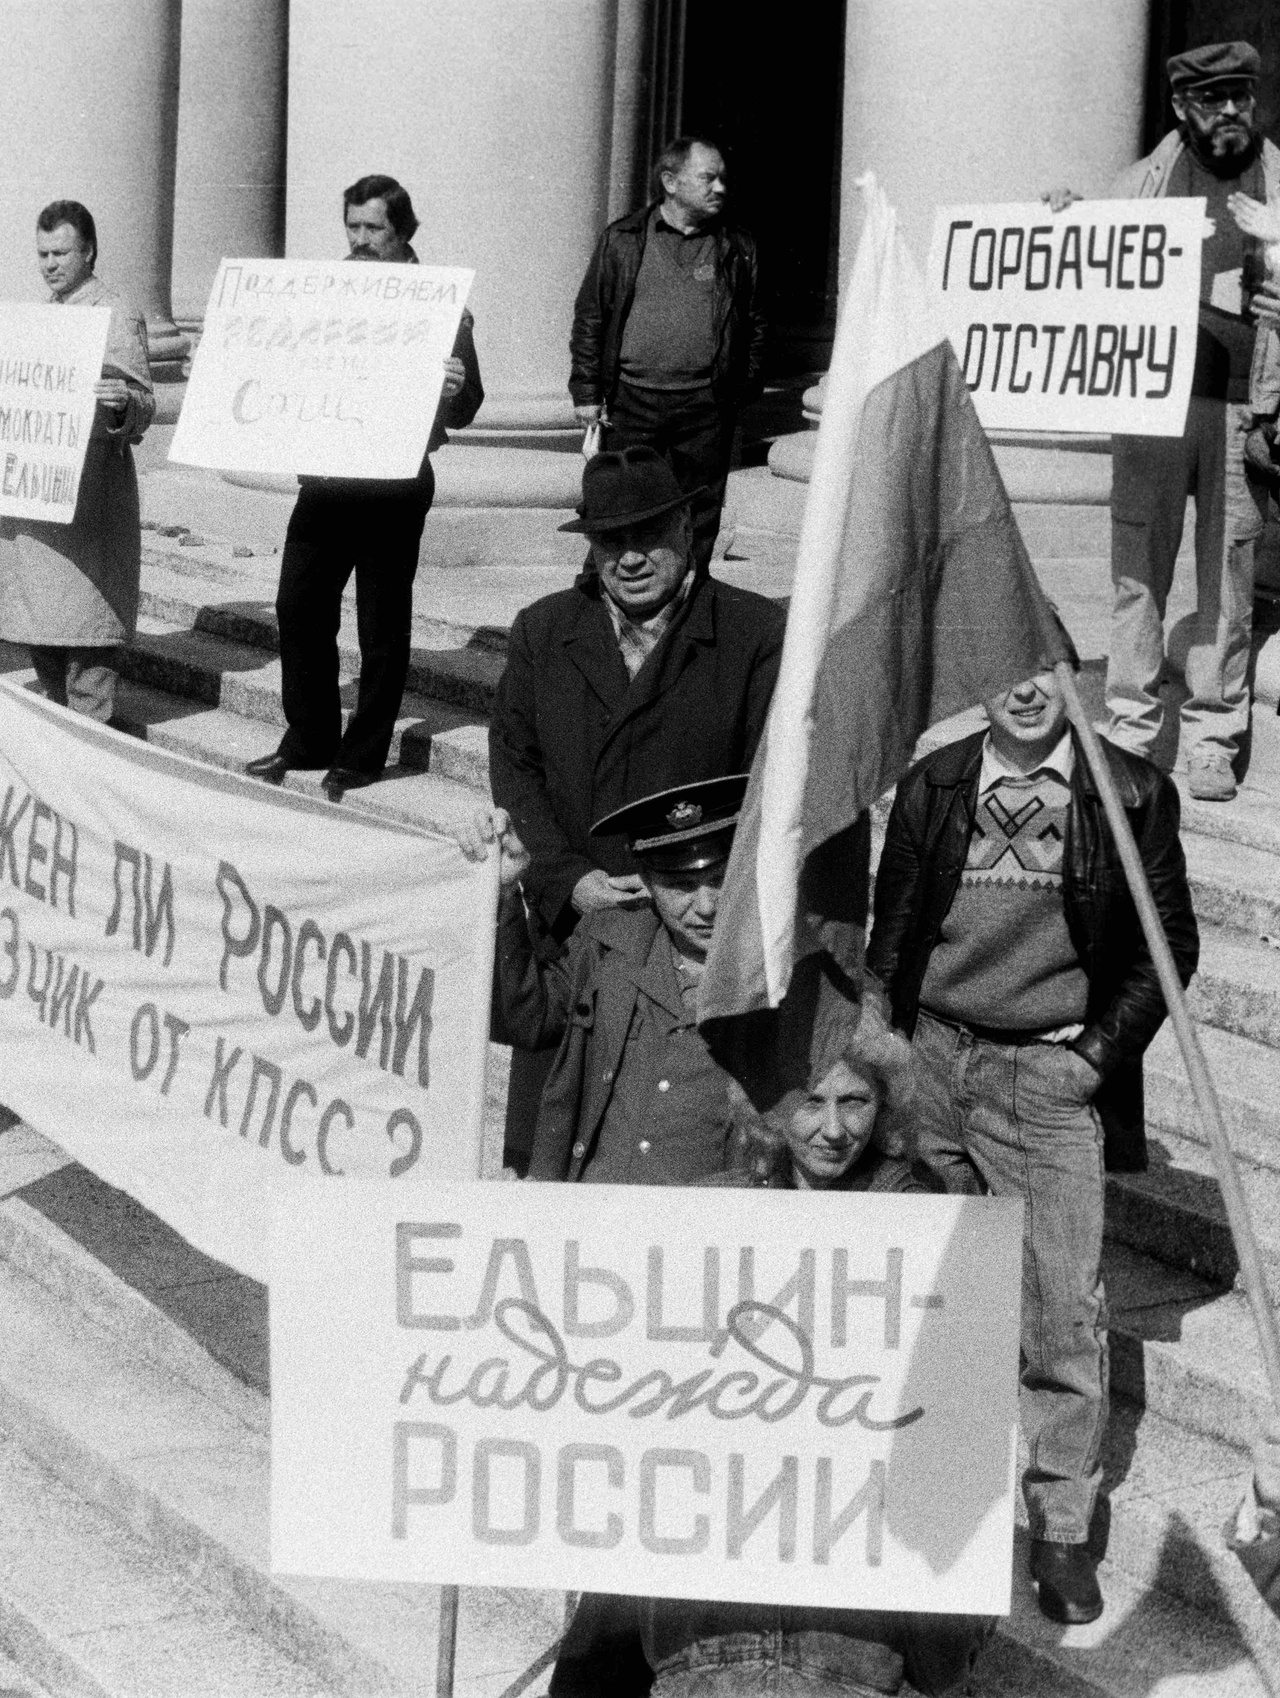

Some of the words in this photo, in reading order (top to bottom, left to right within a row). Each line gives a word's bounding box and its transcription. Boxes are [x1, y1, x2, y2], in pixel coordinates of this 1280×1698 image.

[942, 220, 1183, 291] ГОРБАЧЕВ-
[962, 323, 1178, 399] ОТСТАВКУ
[105, 839, 176, 967] ЛИ
[216, 859, 436, 1089] РОССИИ
[129, 1002, 190, 1096] ОТ
[395, 1221, 945, 1359] ЕЛЬЦИН-
[399, 1297, 925, 1431] надежда
[391, 1420, 887, 1567] РОССИИ
